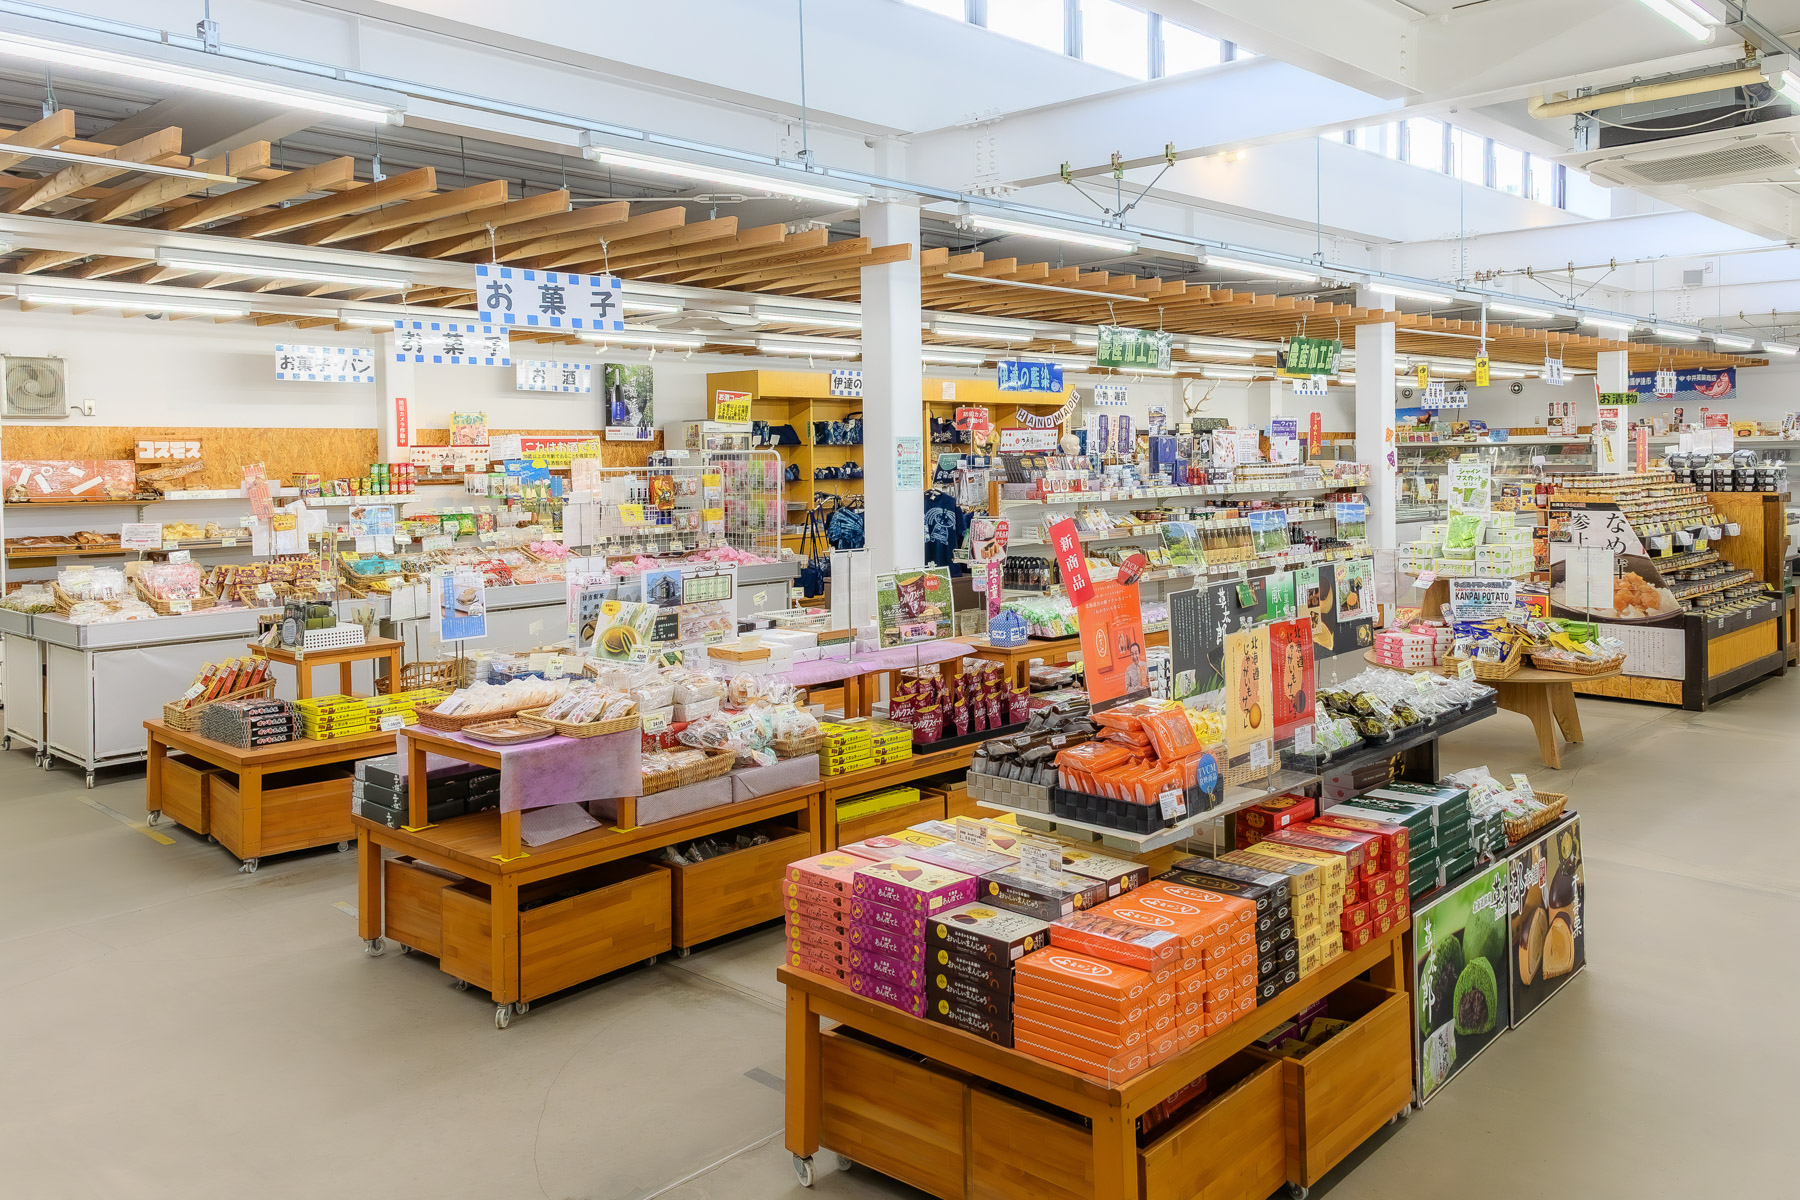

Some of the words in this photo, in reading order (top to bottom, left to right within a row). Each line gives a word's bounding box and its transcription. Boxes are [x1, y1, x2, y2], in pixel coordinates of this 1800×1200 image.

[486, 280, 616, 319] お菓子
[402, 330, 504, 357] お菓子
[1288, 341, 1334, 370] 農産加工品
[532, 367, 577, 387] お酒
[1000, 361, 1051, 388] 伊達の藍染
[1600, 393, 1638, 404] お漬物
[1017, 391, 1079, 427] HANDMADE
[138, 440, 202, 459] コスモス
[525, 441, 599, 453] これはお酒です
[1059, 533, 1086, 592] 新商品
[1455, 591, 1480, 601] KANPAI
[1482, 591, 1510, 601] POTATO
[1294, 625, 1304, 669] 北海道
[1251, 635, 1260, 681] 北海道
[913, 716, 942, 730] シルクスイート
[1198, 762, 1217, 778] TVCM
[877, 888, 901, 902] あんぽてと
[942, 892, 965, 905] あんぽてと
[998, 891, 1039, 908] おいしいまんじゅう
[875, 913, 899, 927] あんぽてと
[874, 938, 899, 952] あんぽてと
[946, 933, 988, 953] おいしいまんじゅう
[873, 962, 896, 976] あんぽてと
[947, 959, 990, 980] おいしいまんじゅう
[875, 986, 898, 1001] あんぽてと
[946, 984, 988, 1006] おいしいまんじゅう
[948, 1009, 990, 1032] おいしいまんじゅう
